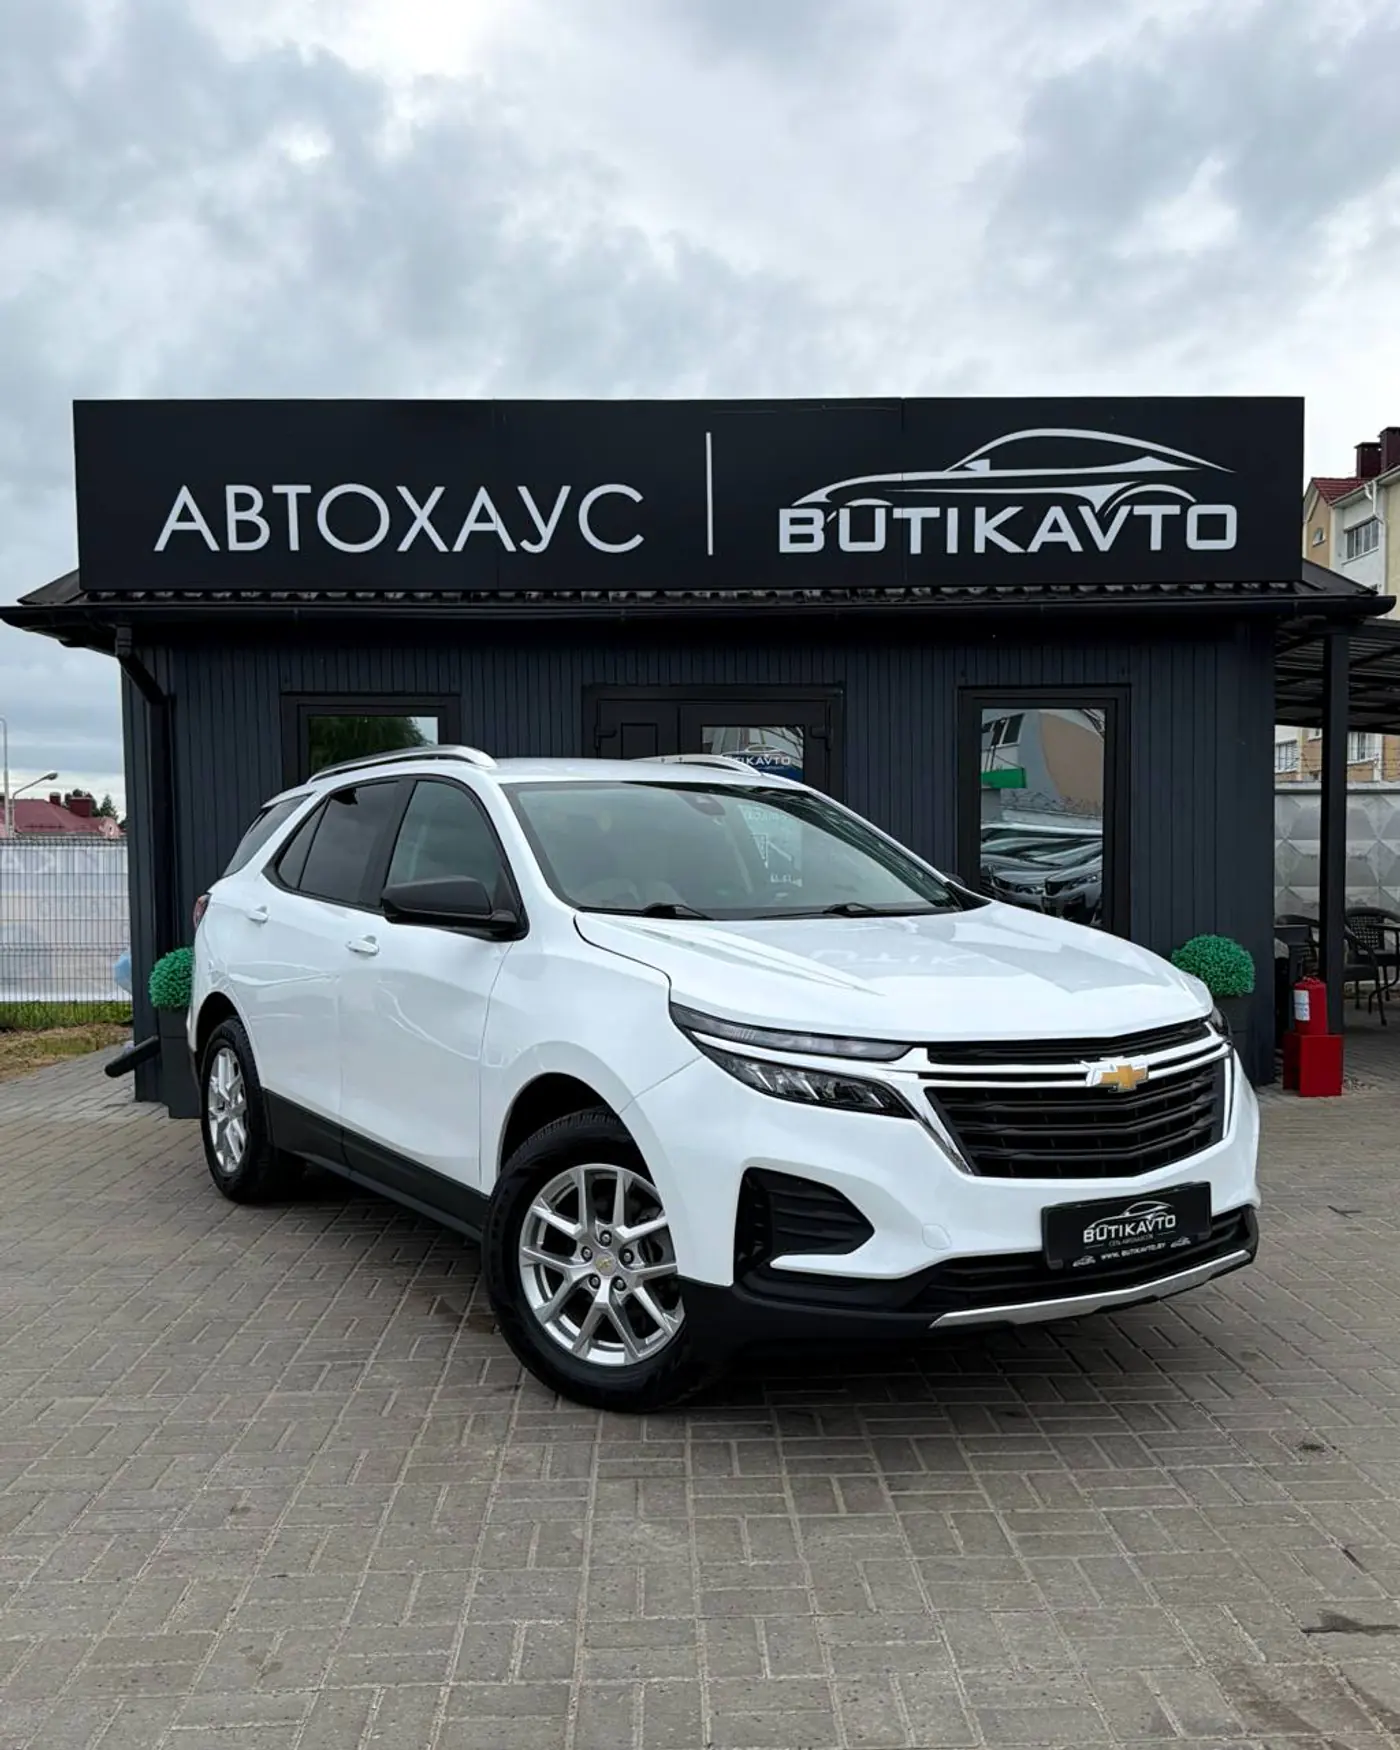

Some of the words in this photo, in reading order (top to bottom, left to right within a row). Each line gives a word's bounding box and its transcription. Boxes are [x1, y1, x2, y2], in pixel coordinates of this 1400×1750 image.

[153, 483, 645, 554] АВТОХАУС
[778, 503, 1238, 554] BUTIKAVTO
[1083, 1214, 1176, 1243] BUTIKAVTO
